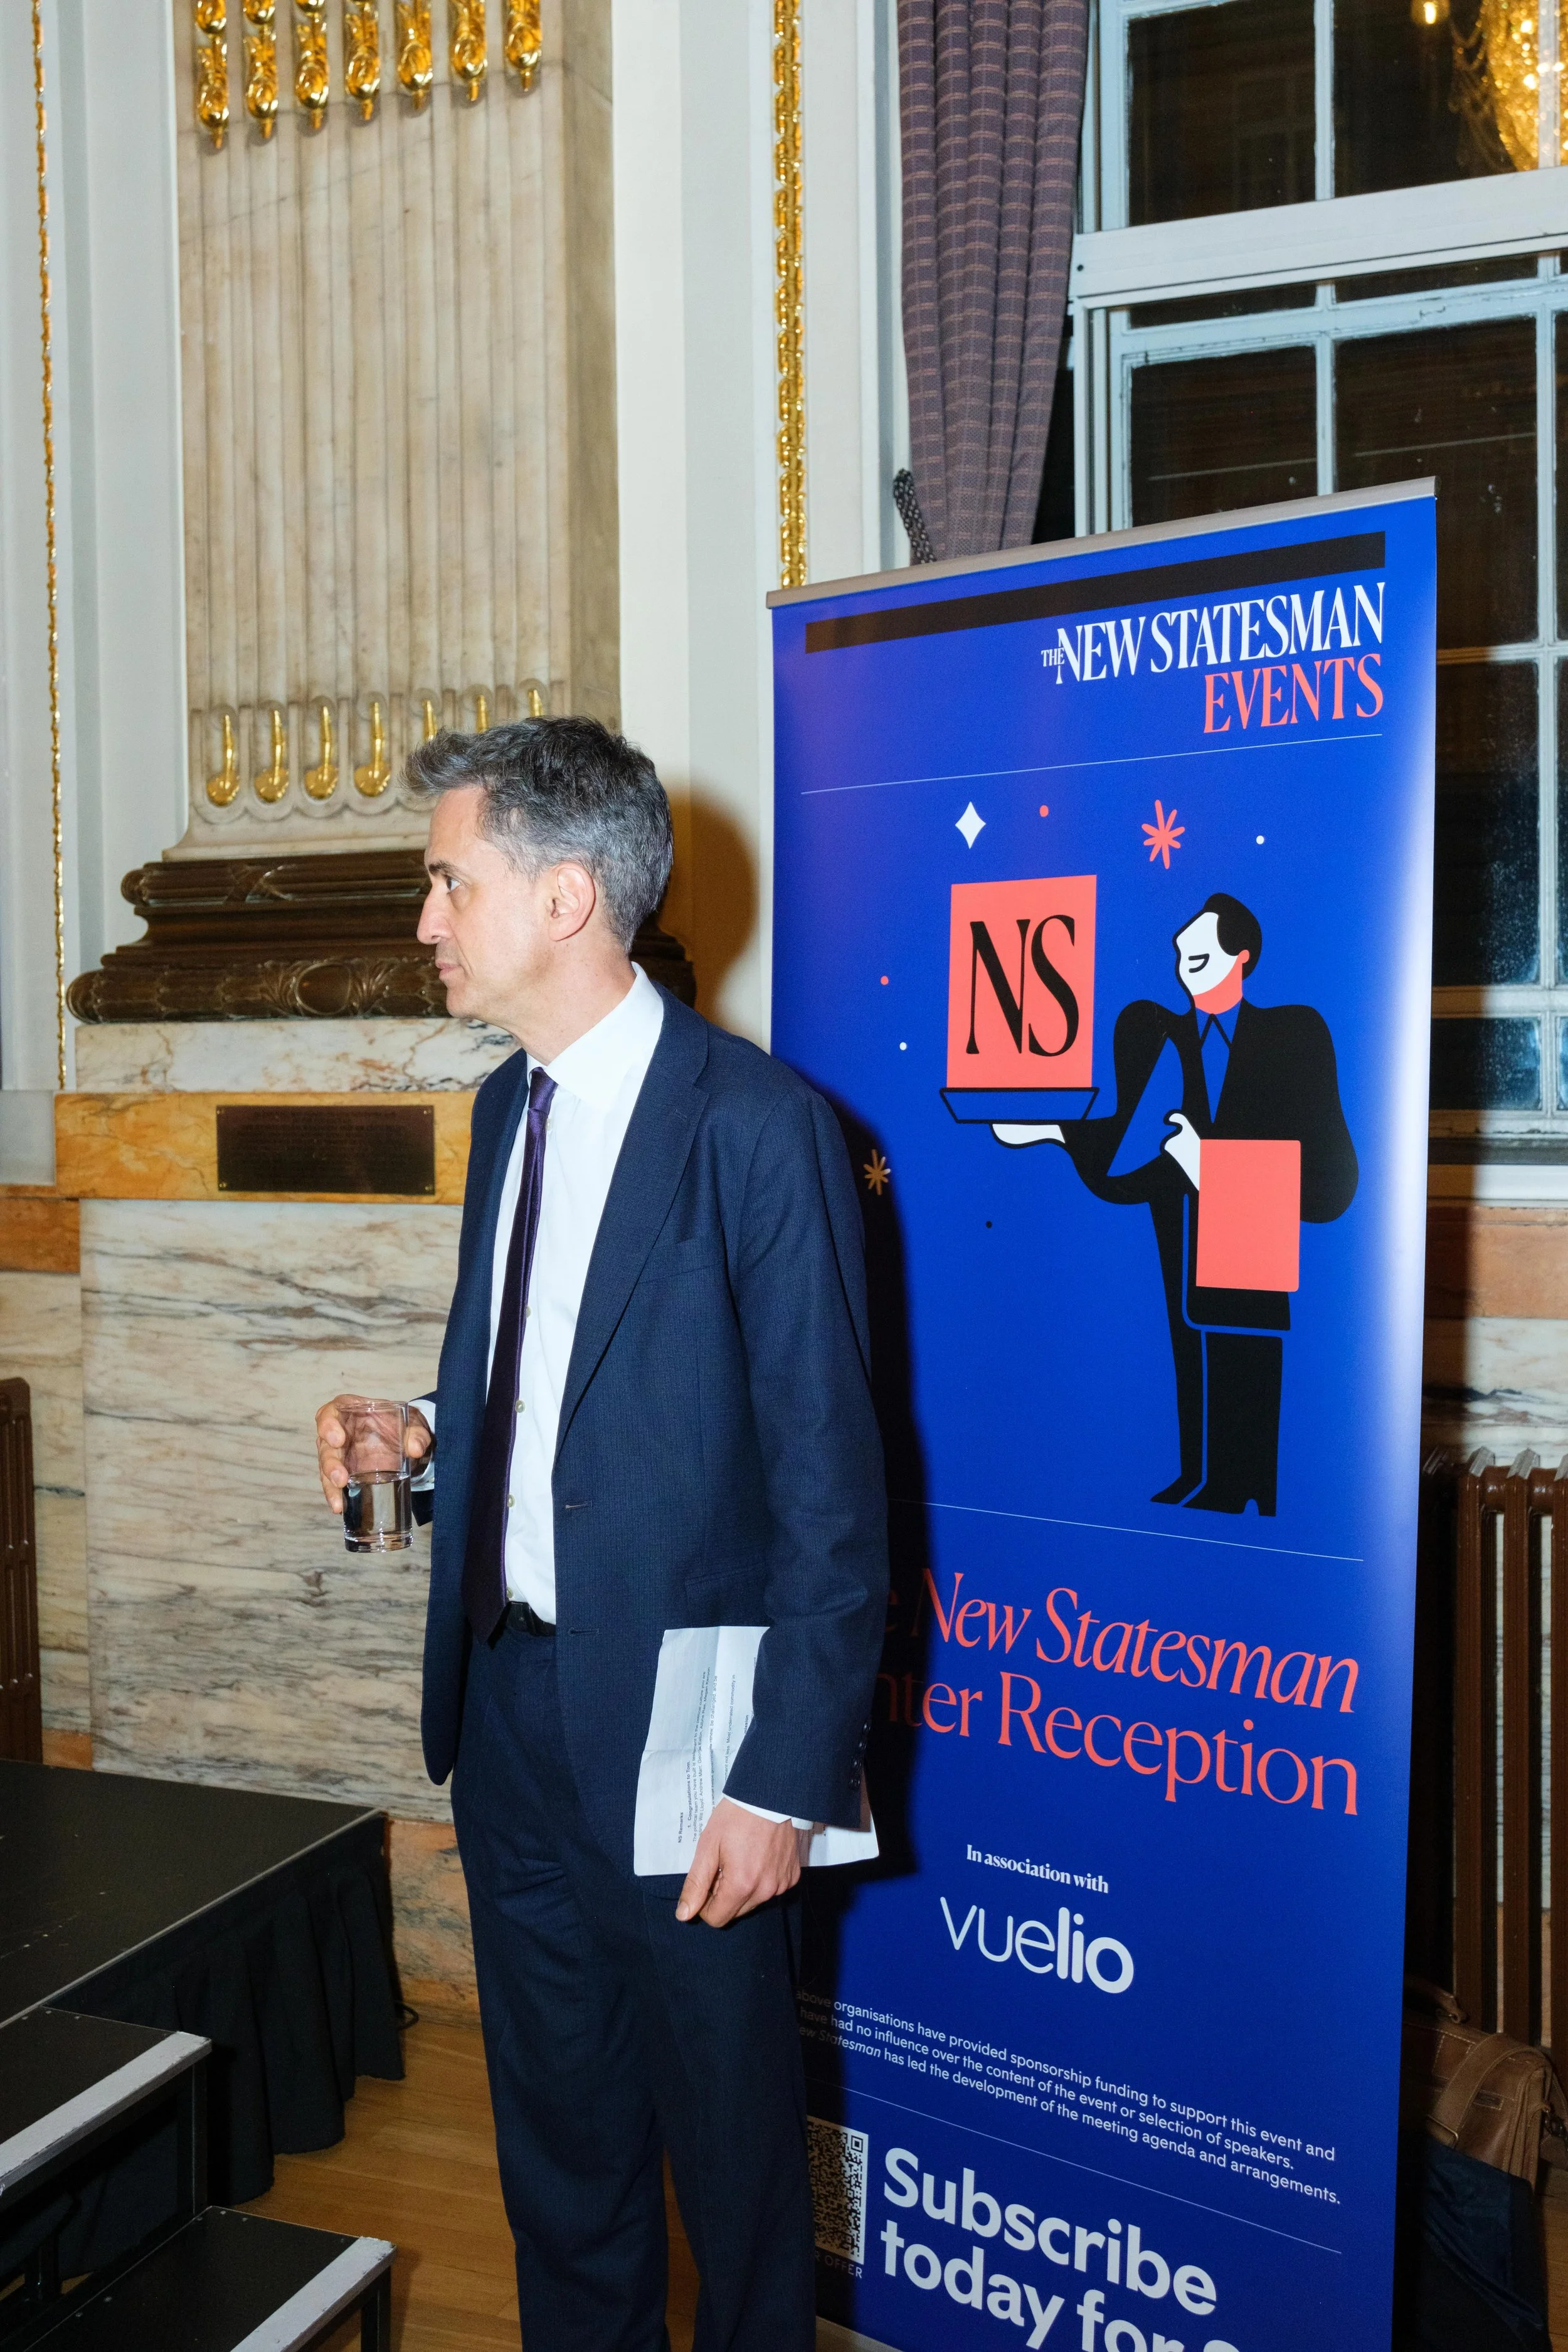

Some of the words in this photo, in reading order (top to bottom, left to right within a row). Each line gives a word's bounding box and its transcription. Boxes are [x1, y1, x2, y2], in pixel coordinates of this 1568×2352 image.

[1041, 647, 1065, 667] THE
[1056, 615, 1146, 684] NEW
[1150, 581, 1385, 674] STATESMAN
[1203, 653, 1384, 734] EVENTS
[965, 914, 1079, 1057] NS
[912, 1567, 1032, 1655] New
[1036, 1587, 1359, 1714] Statesman
[876, 1671, 982, 1738] nter
[997, 1670, 1359, 1816] Reception
[967, 1844, 982, 1863] In
[983, 1853, 1071, 1885] association
[1073, 1873, 1109, 1894] with
[939, 1896, 1135, 1994] vuelio
[799, 2026, 816, 2038] ew
[818, 2030, 881, 2058] Statesman
[884, 2047, 904, 2065] has
[908, 2055, 926, 2073] led
[930, 2063, 950, 2080] the
[952, 2071, 1038, 2107] development
[1040, 2100, 1056, 2112] of
[1057, 2103, 1079, 2121] the
[1082, 2114, 1138, 2143] meeting
[1142, 2132, 1195, 2158] agenda
[1199, 2151, 1226, 2168] and
[1231, 2161, 1340, 2205] arrangements.
[800, 2006, 827, 2024] have
[830, 2014, 852, 2032] had
[856, 2025, 872, 2037] no
[875, 2027, 929, 2055] influence
[932, 2048, 960, 2064] over
[962, 2055, 983, 2072] the
[986, 2065, 1036, 2088] content
[1037, 2080, 1053, 2093] of
[1054, 2084, 1076, 2100] the
[1079, 2094, 1117, 2113] event
[1120, 2107, 1136, 2119] or
[1138, 2112, 1202, 2140] selection
[1206, 2132, 1222, 2146] of
[1224, 2138, 1294, 2169] speakers.
[834, 2001, 914, 2032] organisations
[918, 2021, 946, 2042] have
[949, 2035, 1007, 2061] provided
[1010, 2054, 1091, 2089] sponsorship
[1094, 2076, 1148, 2107] funding
[1152, 2094, 1167, 2109] to
[1170, 2102, 1227, 2127] support
[1231, 2117, 1256, 2137] this
[1260, 2130, 1302, 2151] event
[1305, 2144, 1335, 2161] and
[824, 2255, 863, 2280] OFFER
[880, 2219, 1066, 2350] today
[883, 2147, 1217, 2316] Subscribe
